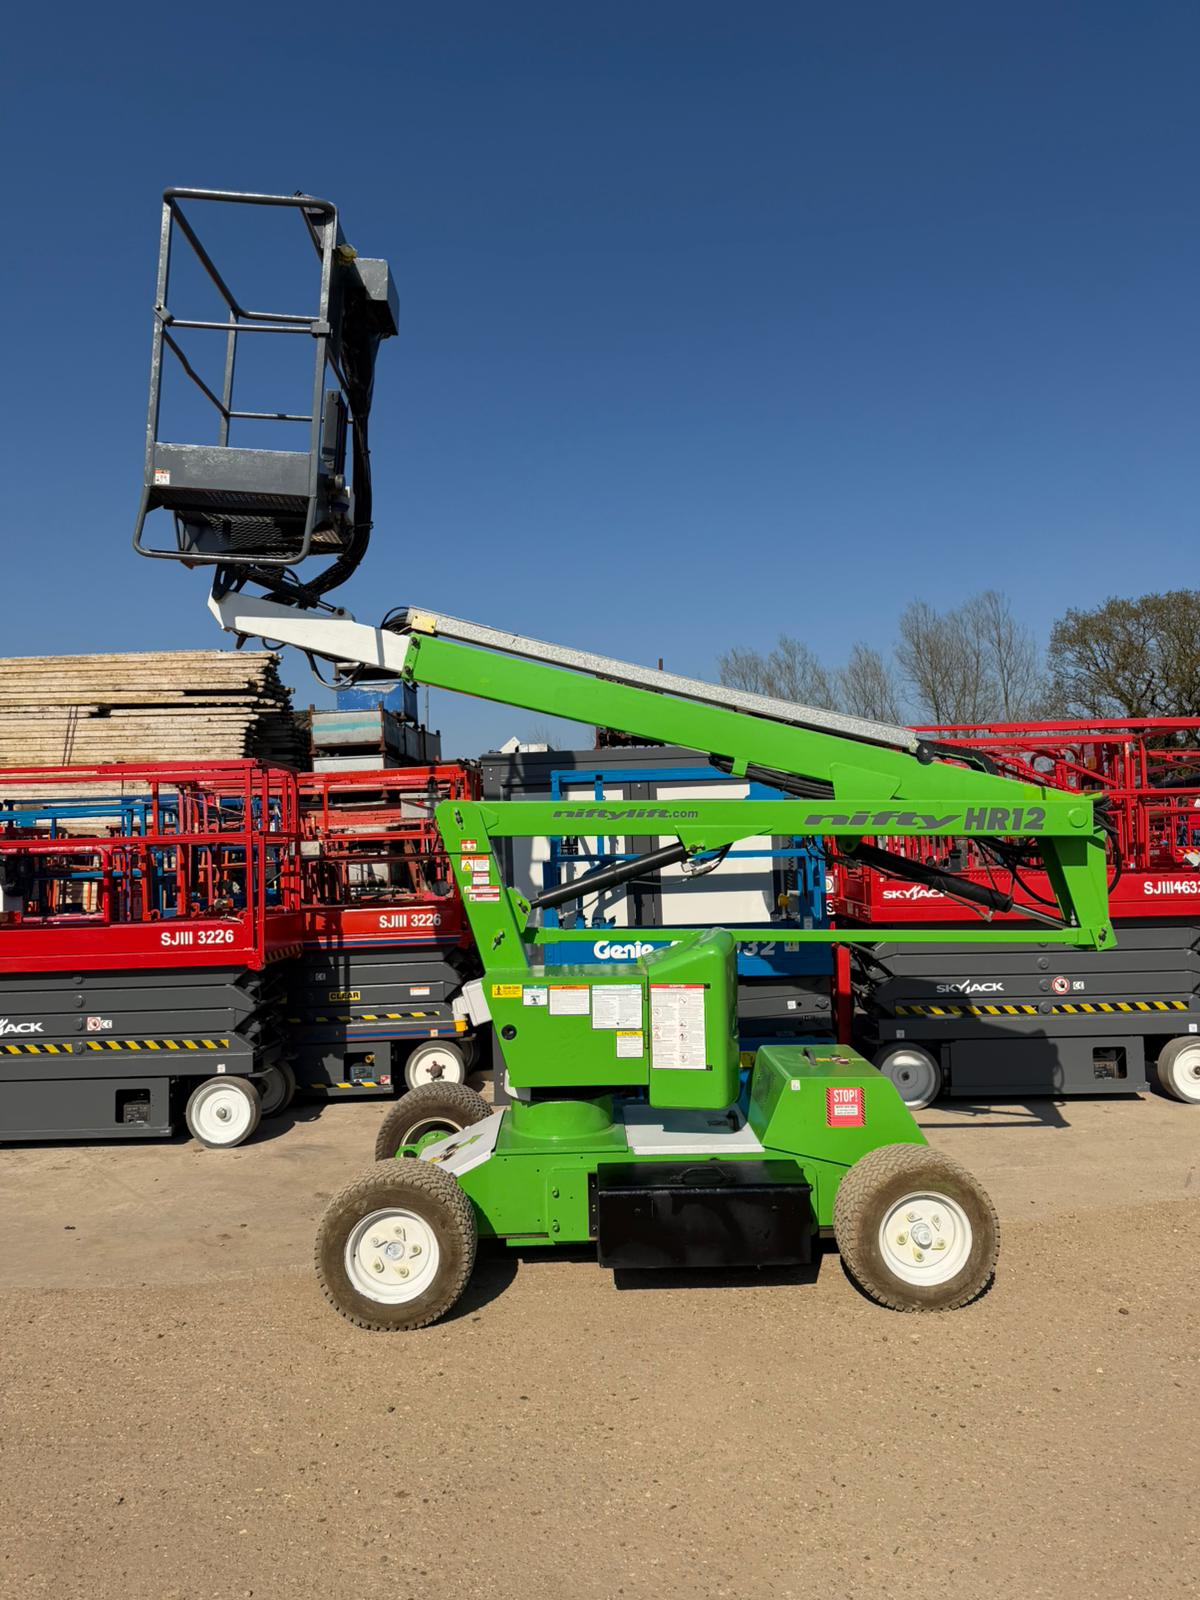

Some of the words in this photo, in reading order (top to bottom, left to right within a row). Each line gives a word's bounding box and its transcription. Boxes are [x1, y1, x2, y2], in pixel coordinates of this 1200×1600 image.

[553, 808, 698, 820] niftylift.com
[804, 810, 963, 830] nifty
[963, 807, 1046, 831] HR12
[882, 885, 947, 900] SKYJAC
[411, 913, 441, 927] 3226
[161, 931, 193, 946] SJIII
[197, 929, 234, 946] 3226
[593, 940, 655, 960] Genie
[936, 979, 1005, 994] SKYJACK
[330, 991, 360, 1000] CLEAR
[833, 1089, 858, 1103] STOP!
